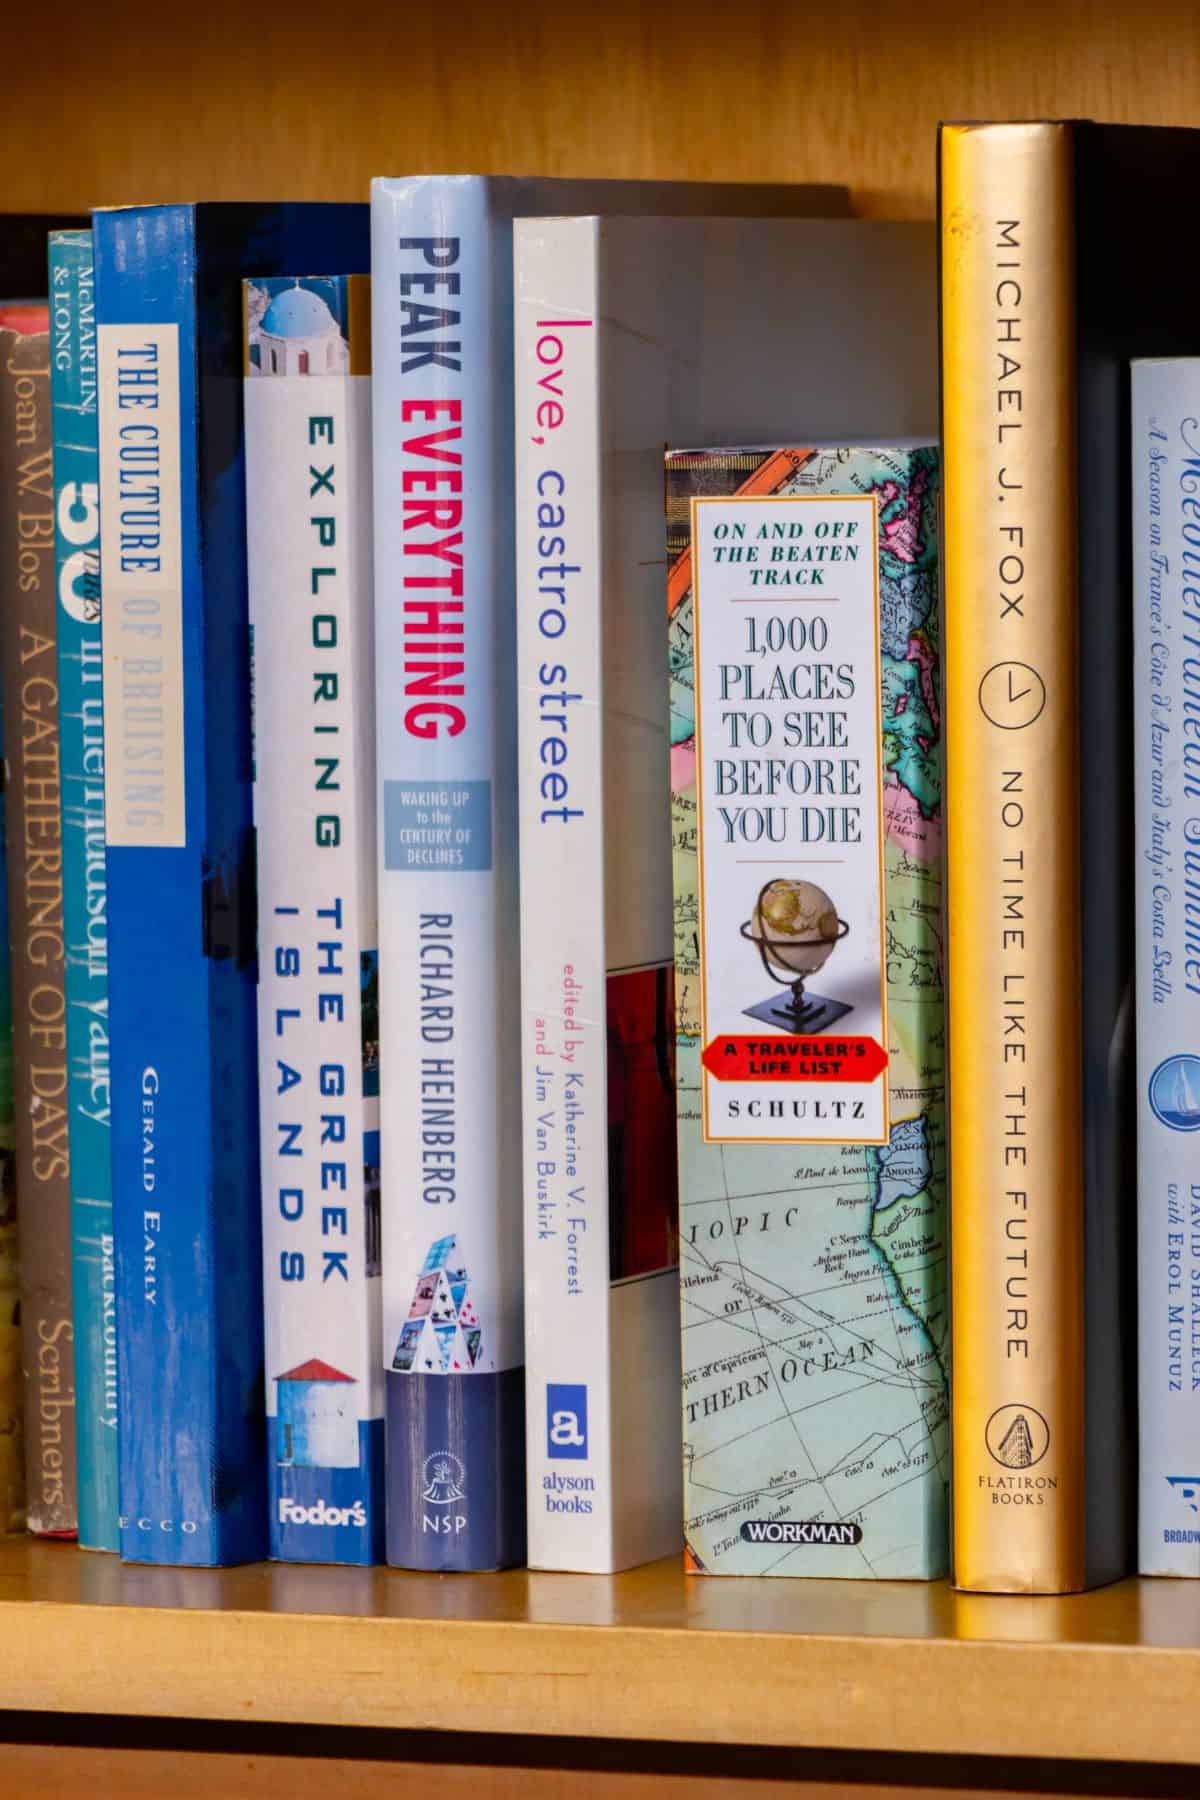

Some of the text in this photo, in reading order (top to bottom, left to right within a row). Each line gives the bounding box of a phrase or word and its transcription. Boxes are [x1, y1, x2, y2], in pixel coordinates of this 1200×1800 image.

[54, 267, 71, 371] & LONG
[996, 220, 1025, 619] MICHAEL J. FOX
[1148, 416, 1169, 441] A
[399, 237, 466, 740] PEAK EVERYTHING
[1149, 448, 1169, 517] Season
[713, 522, 859, 540] ON AND OFF
[1149, 523, 1161, 545] on
[531, 320, 593, 824] love, castro street
[713, 545, 860, 562] THE BEATEN
[118, 344, 164, 826] THE CULTURE OF BRUISING
[750, 569, 825, 585] TRACK
[1149, 551, 1171, 635] France's
[744, 615, 829, 657] 1,000
[718, 664, 856, 700] PLACES
[1150, 641, 1171, 688] Côte
[722, 711, 849, 749] TO SEE
[6, 359, 70, 1181] Joan W. Blos A GATHERING OF DAYS
[713, 759, 862, 796] BEFORE
[1151, 768, 1172, 808] and
[400, 791, 471, 807] WAKING UP
[416, 810, 429, 825] to
[400, 828, 473, 845] CENTURY OF
[716, 807, 788, 843] YOU
[800, 807, 863, 843] DIE
[308, 415, 349, 1283] EXPLORING THE GREEK
[407, 848, 464, 865] DECLINES
[1144, 815, 1173, 877] Italy's
[1151, 884, 1172, 939] Costa
[1151, 944, 1173, 1005] Bella
[420, 913, 456, 1205] RICHARD HEINBERG
[724, 1042, 866, 1057] A TRAVELER'S
[749, 1061, 842, 1075] LIFE LIST
[1001, 771, 1028, 1360] NO TIME LIKE THE FUTURE
[274, 906, 305, 1282] ISLANDS
[727, 1100, 867, 1119] SCHULTZ
[534, 1018, 557, 1240] and Jim Van Buskirk
[560, 964, 587, 1296] edited by Katherine V. Forrest
[885, 1166, 924, 1178] ANGOLA
[1167, 1183, 1185, 1392] with EROL MUNUZ
[780, 1338, 876, 1384] OCEAN
[37, 1319, 76, 1505] Scribners
[543, 1471, 595, 1492] alyson
[978, 1475, 1058, 1489] FLATIRON
[992, 1492, 1044, 1505] BOOKS
[279, 1498, 367, 1527] Fodor's
[423, 1514, 467, 1534] NSP
[545, 1498, 593, 1513] books
[119, 1516, 197, 1534] ECCO
[747, 1523, 855, 1543] WORKMAN
